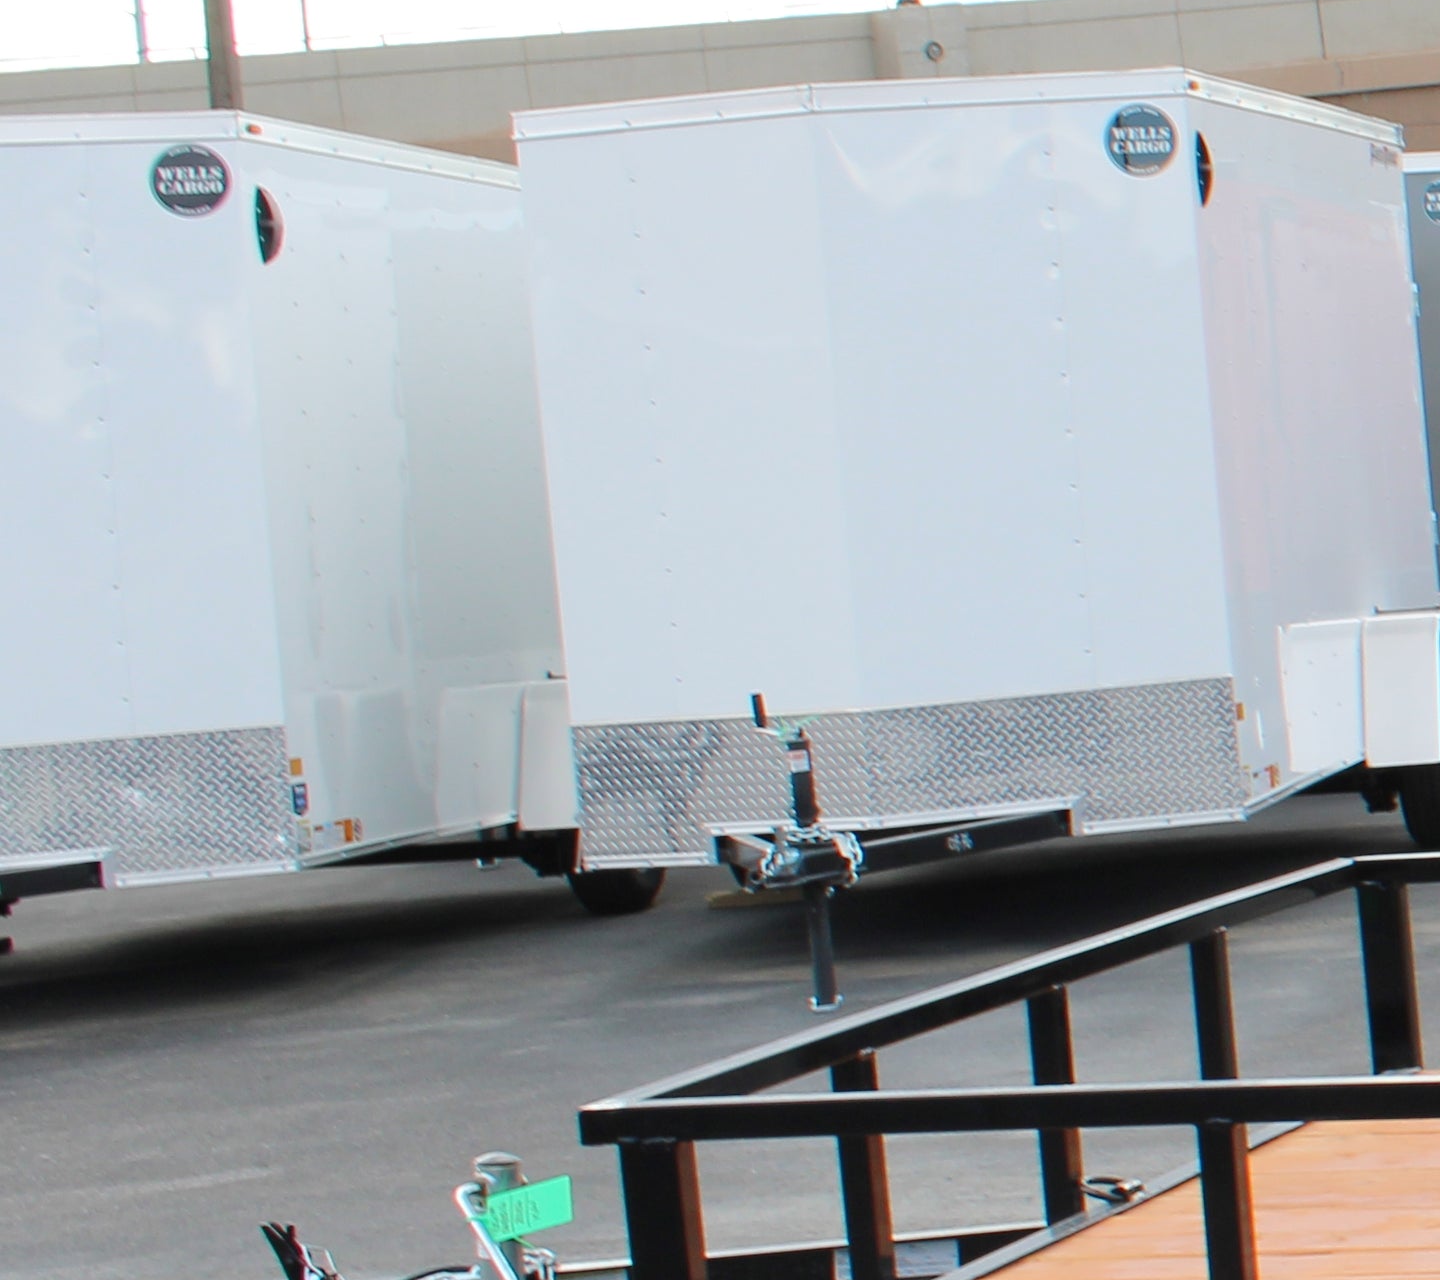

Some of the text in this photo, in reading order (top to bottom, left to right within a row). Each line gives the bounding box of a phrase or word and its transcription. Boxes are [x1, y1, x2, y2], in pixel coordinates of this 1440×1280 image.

[1110, 126, 1172, 140] WELLS
[1110, 140, 1172, 154] CARGO
[156, 166, 225, 180] WELLS
[156, 180, 225, 195] CARGO
